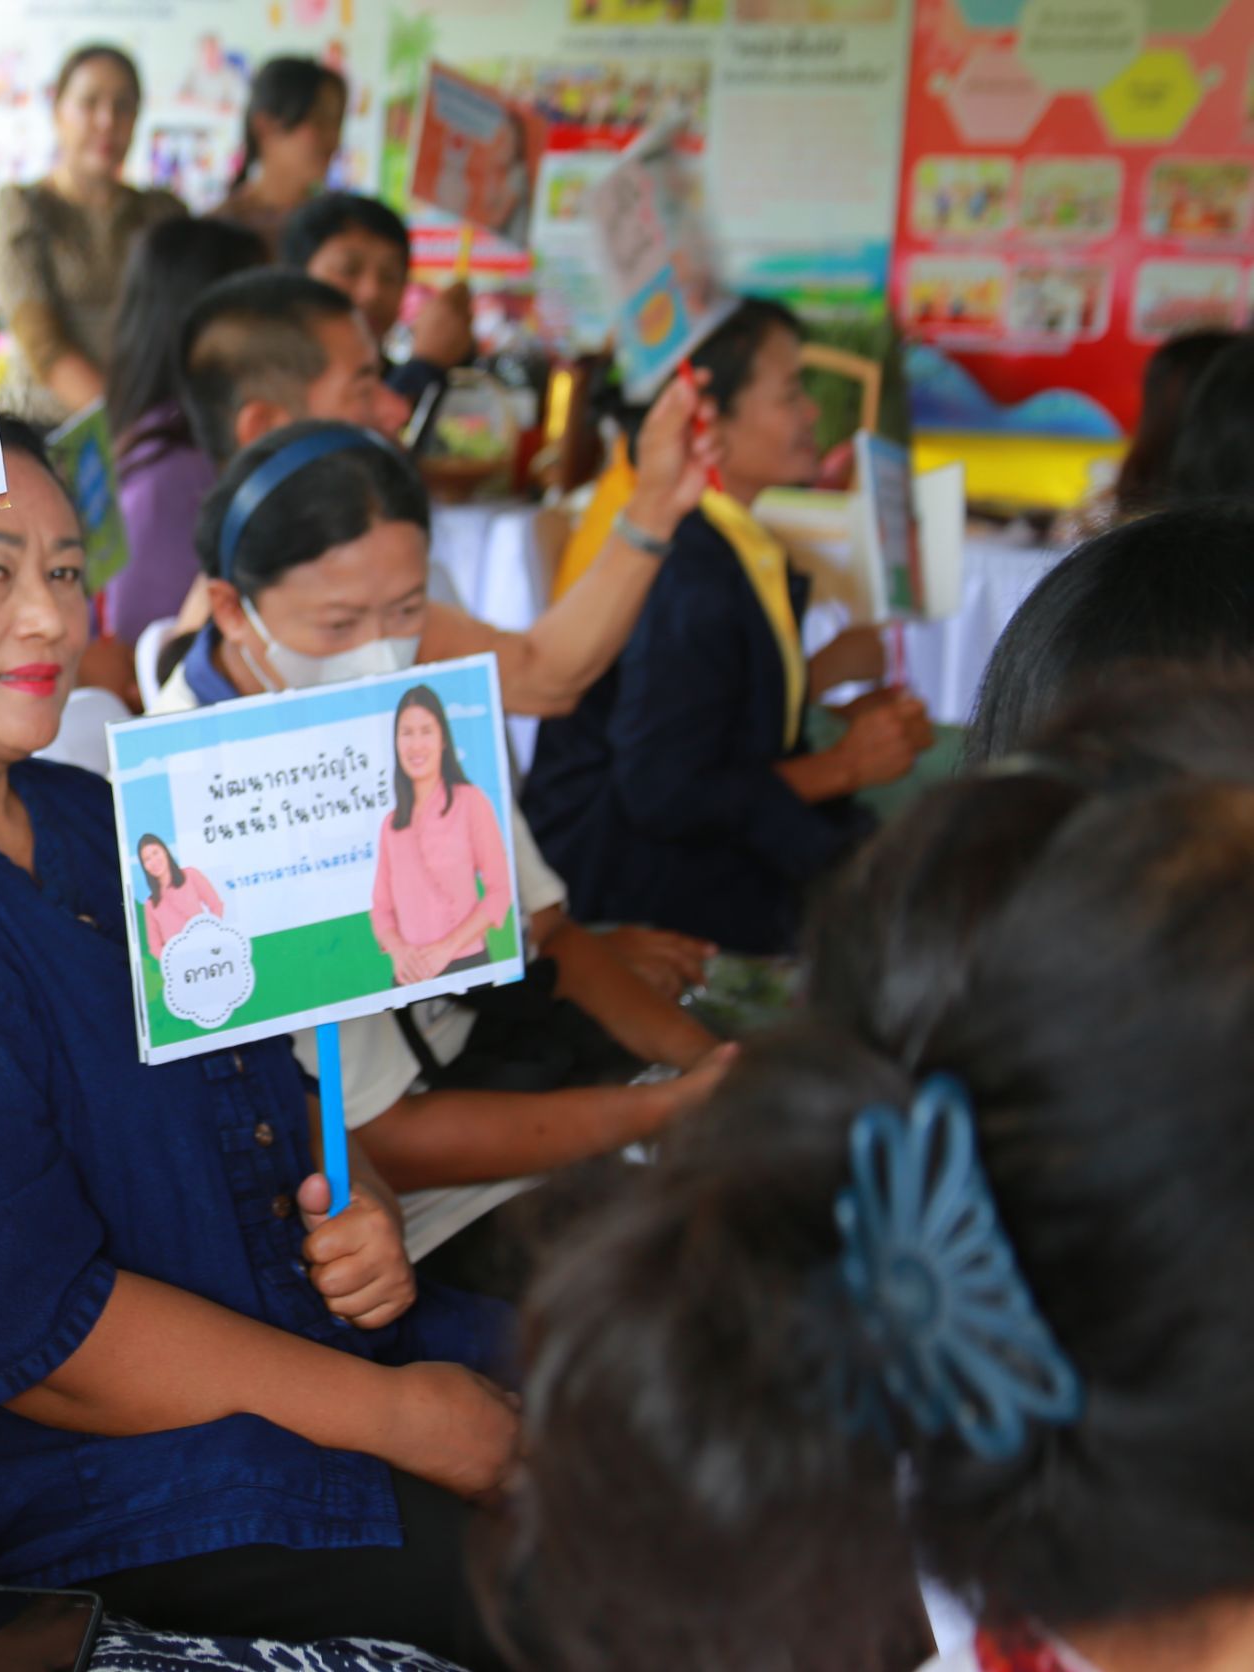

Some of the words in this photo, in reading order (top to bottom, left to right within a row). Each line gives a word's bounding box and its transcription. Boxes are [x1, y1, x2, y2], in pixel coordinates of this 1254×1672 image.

[208, 745, 369, 801] พัฒนากรขวัญใจ
[203, 797, 278, 845] ยืนหนึ่ง
[280, 768, 390, 827] ในบ้านโพธิ์
